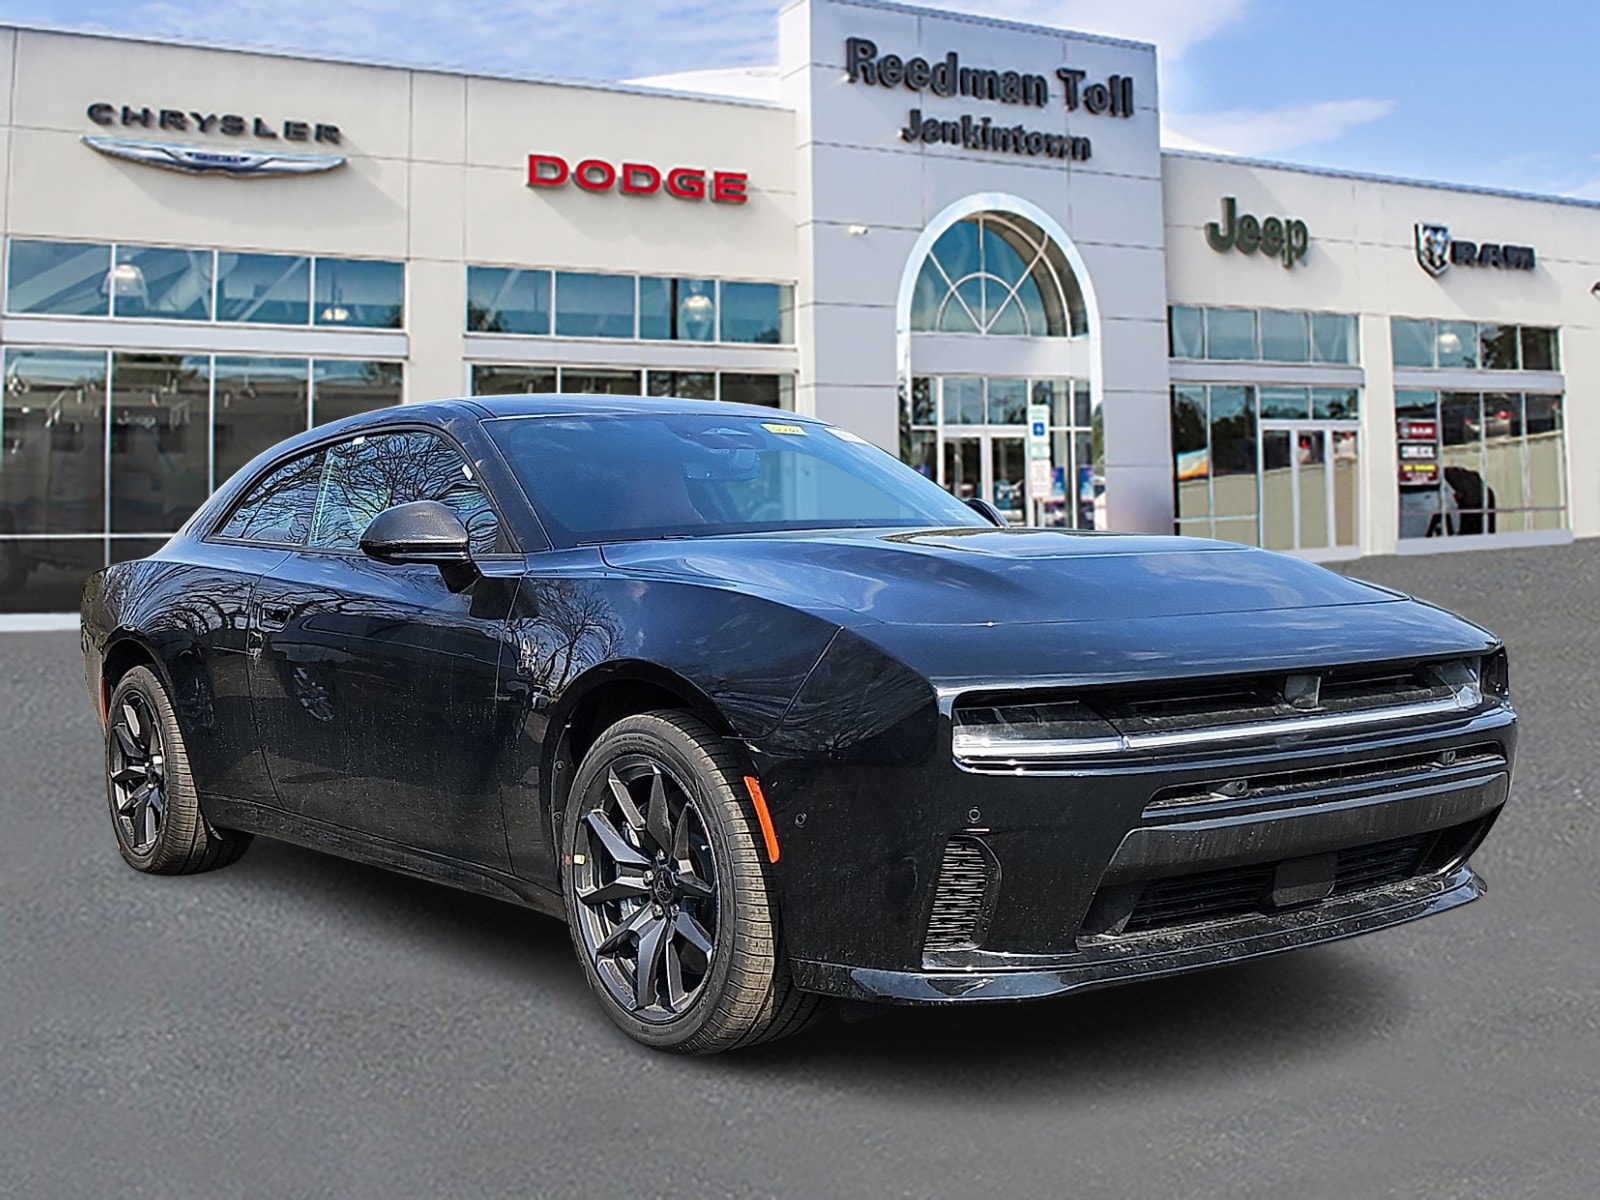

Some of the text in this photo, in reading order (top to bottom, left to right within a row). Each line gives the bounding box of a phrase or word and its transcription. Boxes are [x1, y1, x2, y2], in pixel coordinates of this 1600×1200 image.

[846, 37, 1135, 118] Reedman Toll
[87, 103, 343, 144] CHRYSLER
[901, 109, 1092, 161] Jenkintown
[527, 154, 748, 204] DODGE
[1205, 197, 1308, 269] Jeep
[1449, 241, 1535, 270] RAM
